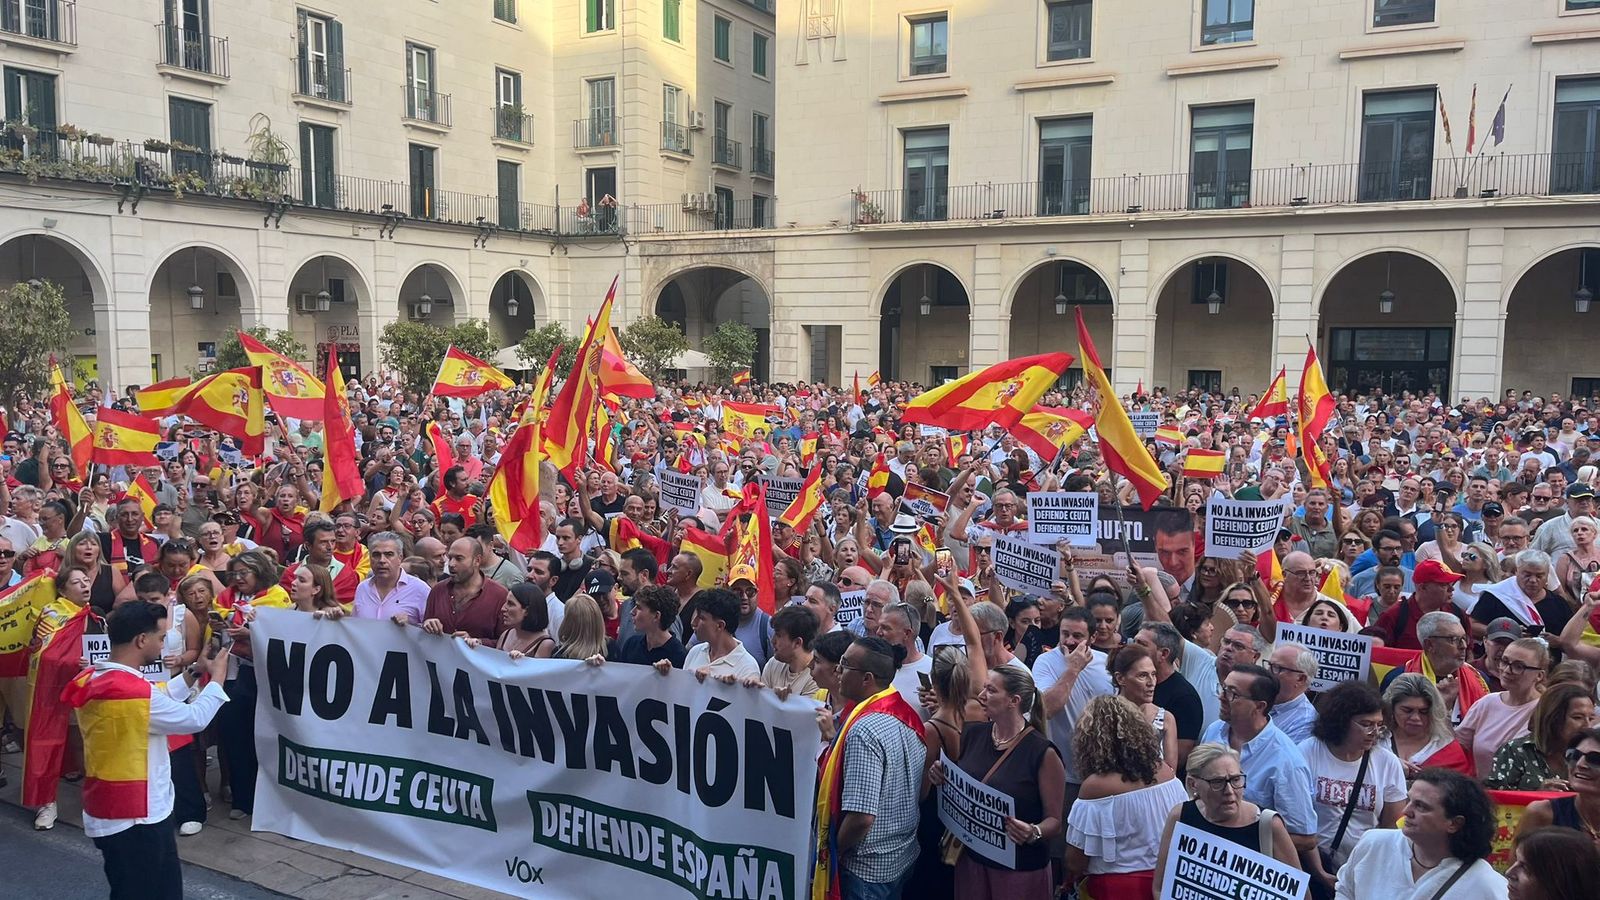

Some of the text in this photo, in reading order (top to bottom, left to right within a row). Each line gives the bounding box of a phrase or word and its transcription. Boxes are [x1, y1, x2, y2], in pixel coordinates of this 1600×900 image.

[1032, 496, 1095, 508] NO A LA INVASIÓN
[1211, 503, 1284, 519] NO A LA INVASIÓN
[1036, 510, 1090, 521] DEFIENDE CEUTA
[1036, 523, 1090, 534] DEFIENDE ESPAÑA
[1214, 519, 1277, 533] DEFIENDE CEUTA
[995, 538, 1057, 567] NO A LA INVASIÓN
[1214, 535, 1251, 548] DEFIENDE
[996, 566, 1026, 583] DEFIENDE
[997, 552, 1051, 578] DEFIENDE CEUTA
[87, 640, 108, 651] NO A
[1281, 629, 1367, 654] NO A LA INVASIÓN
[1328, 653, 1357, 668] CEUTA
[266, 637, 796, 819] NO A LA INVASIÓN
[285, 745, 488, 822] DEFIENDE CEUTA
[950, 768, 956, 784] A
[955, 773, 964, 792] LA
[965, 781, 1010, 816] INVASIÓN
[943, 782, 1003, 830] DEFIENDE CEUTA
[970, 822, 1003, 848] ESPAÑA
[538, 800, 785, 900] DEFIENDE ESPAÑA
[505, 856, 544, 885] VOX
[1178, 834, 1300, 897] NO A LA INVASIÓN
[1178, 858, 1239, 896] DEFIENDE
